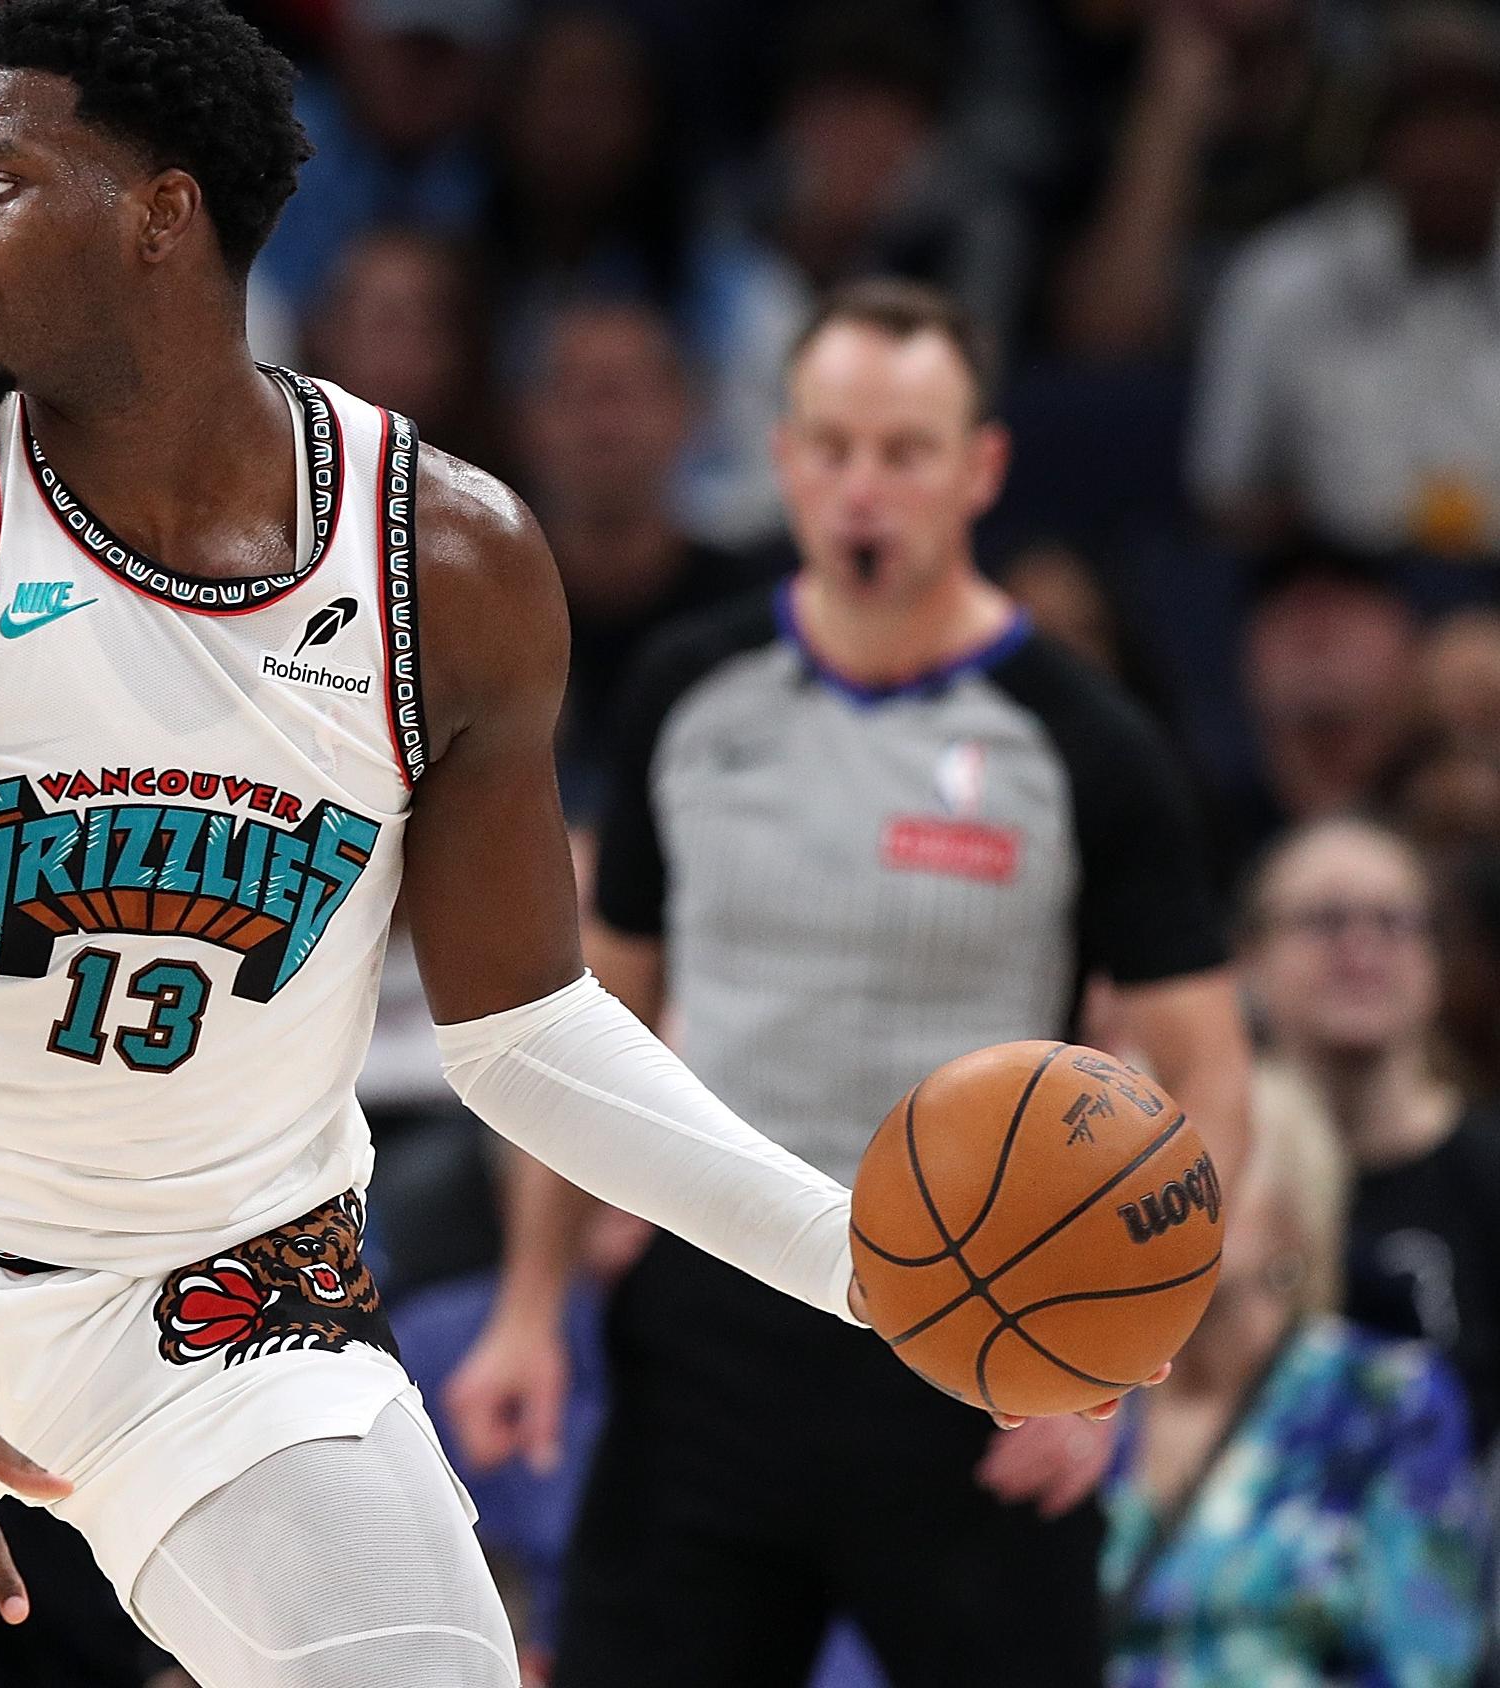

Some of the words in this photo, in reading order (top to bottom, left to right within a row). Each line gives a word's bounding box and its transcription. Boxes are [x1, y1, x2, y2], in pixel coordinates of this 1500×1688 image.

[11, 581, 74, 613] NIKE
[262, 656, 371, 694] Robinhood
[39, 767, 301, 822] VANCOUVER
[46, 946, 211, 1073] 13
